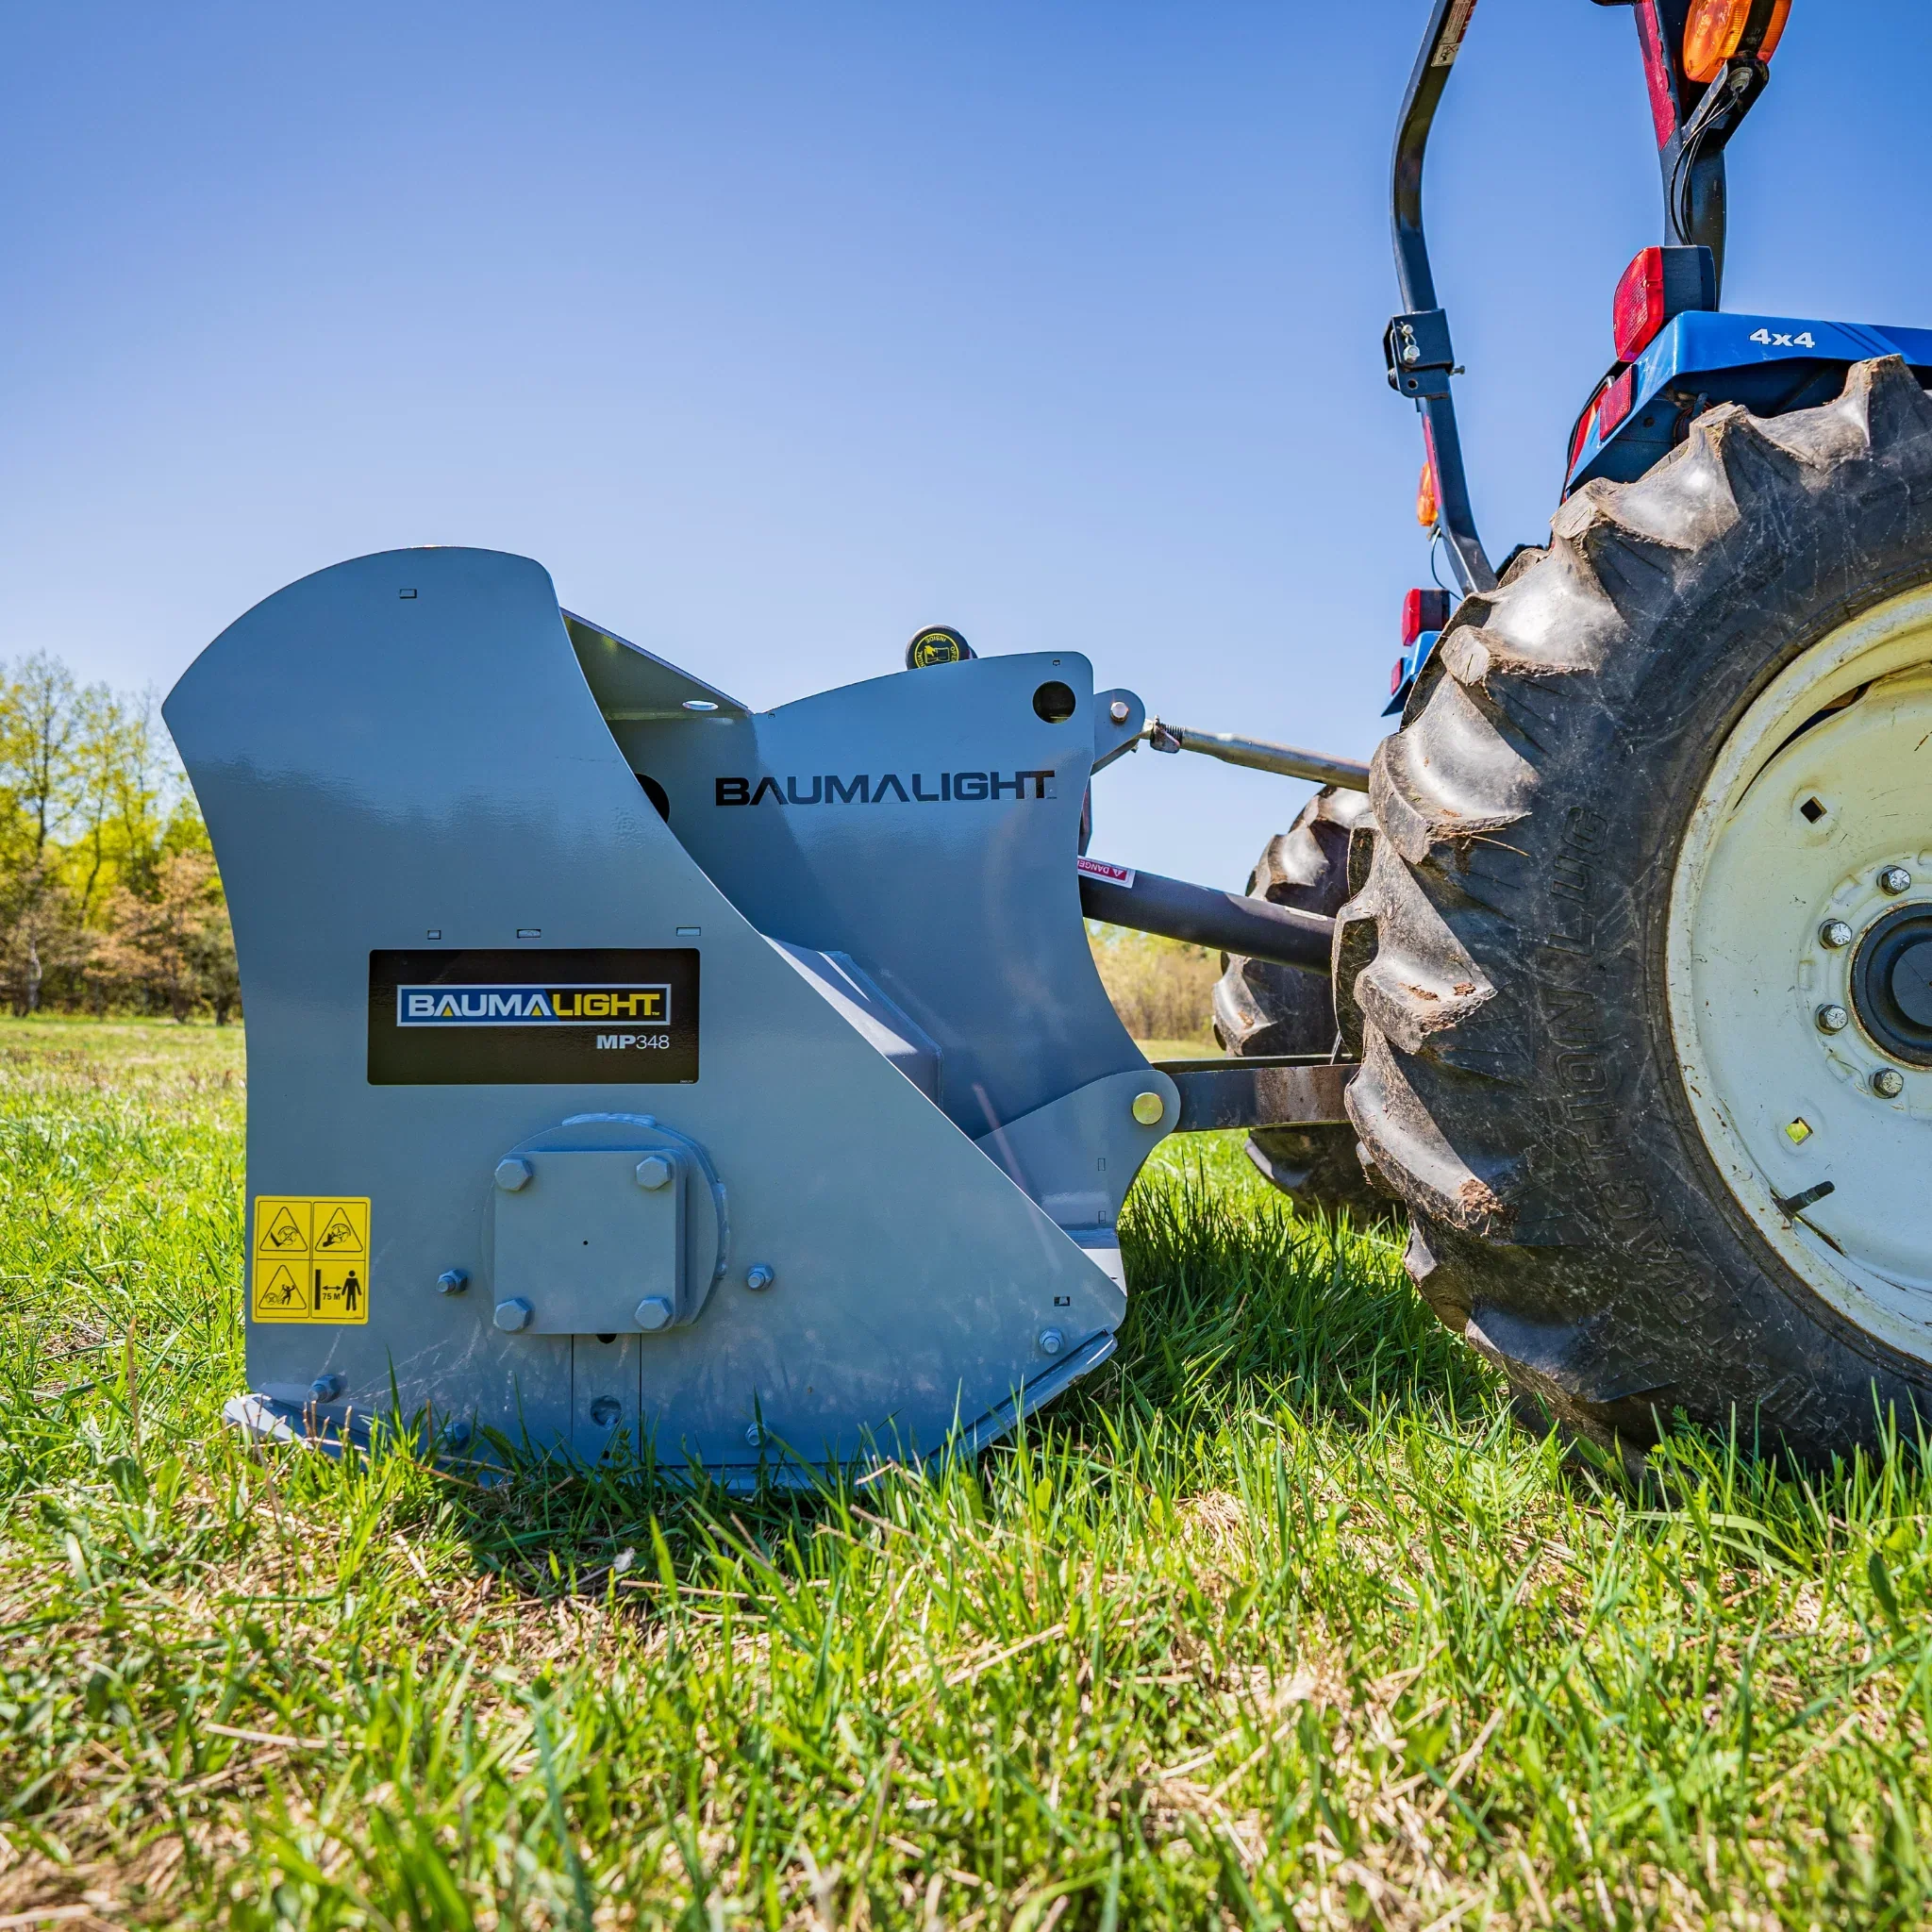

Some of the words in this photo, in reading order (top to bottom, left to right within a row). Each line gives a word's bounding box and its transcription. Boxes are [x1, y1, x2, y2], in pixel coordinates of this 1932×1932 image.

[1749, 327, 1815, 348] 4x4
[715, 770, 1055, 806] BAUMALIGHT
[1077, 859, 1110, 874] DANGE
[408, 993, 659, 1017] BAUMALIGHT
[596, 1035, 670, 1050] MP348
[323, 1292, 332, 1301] 75
